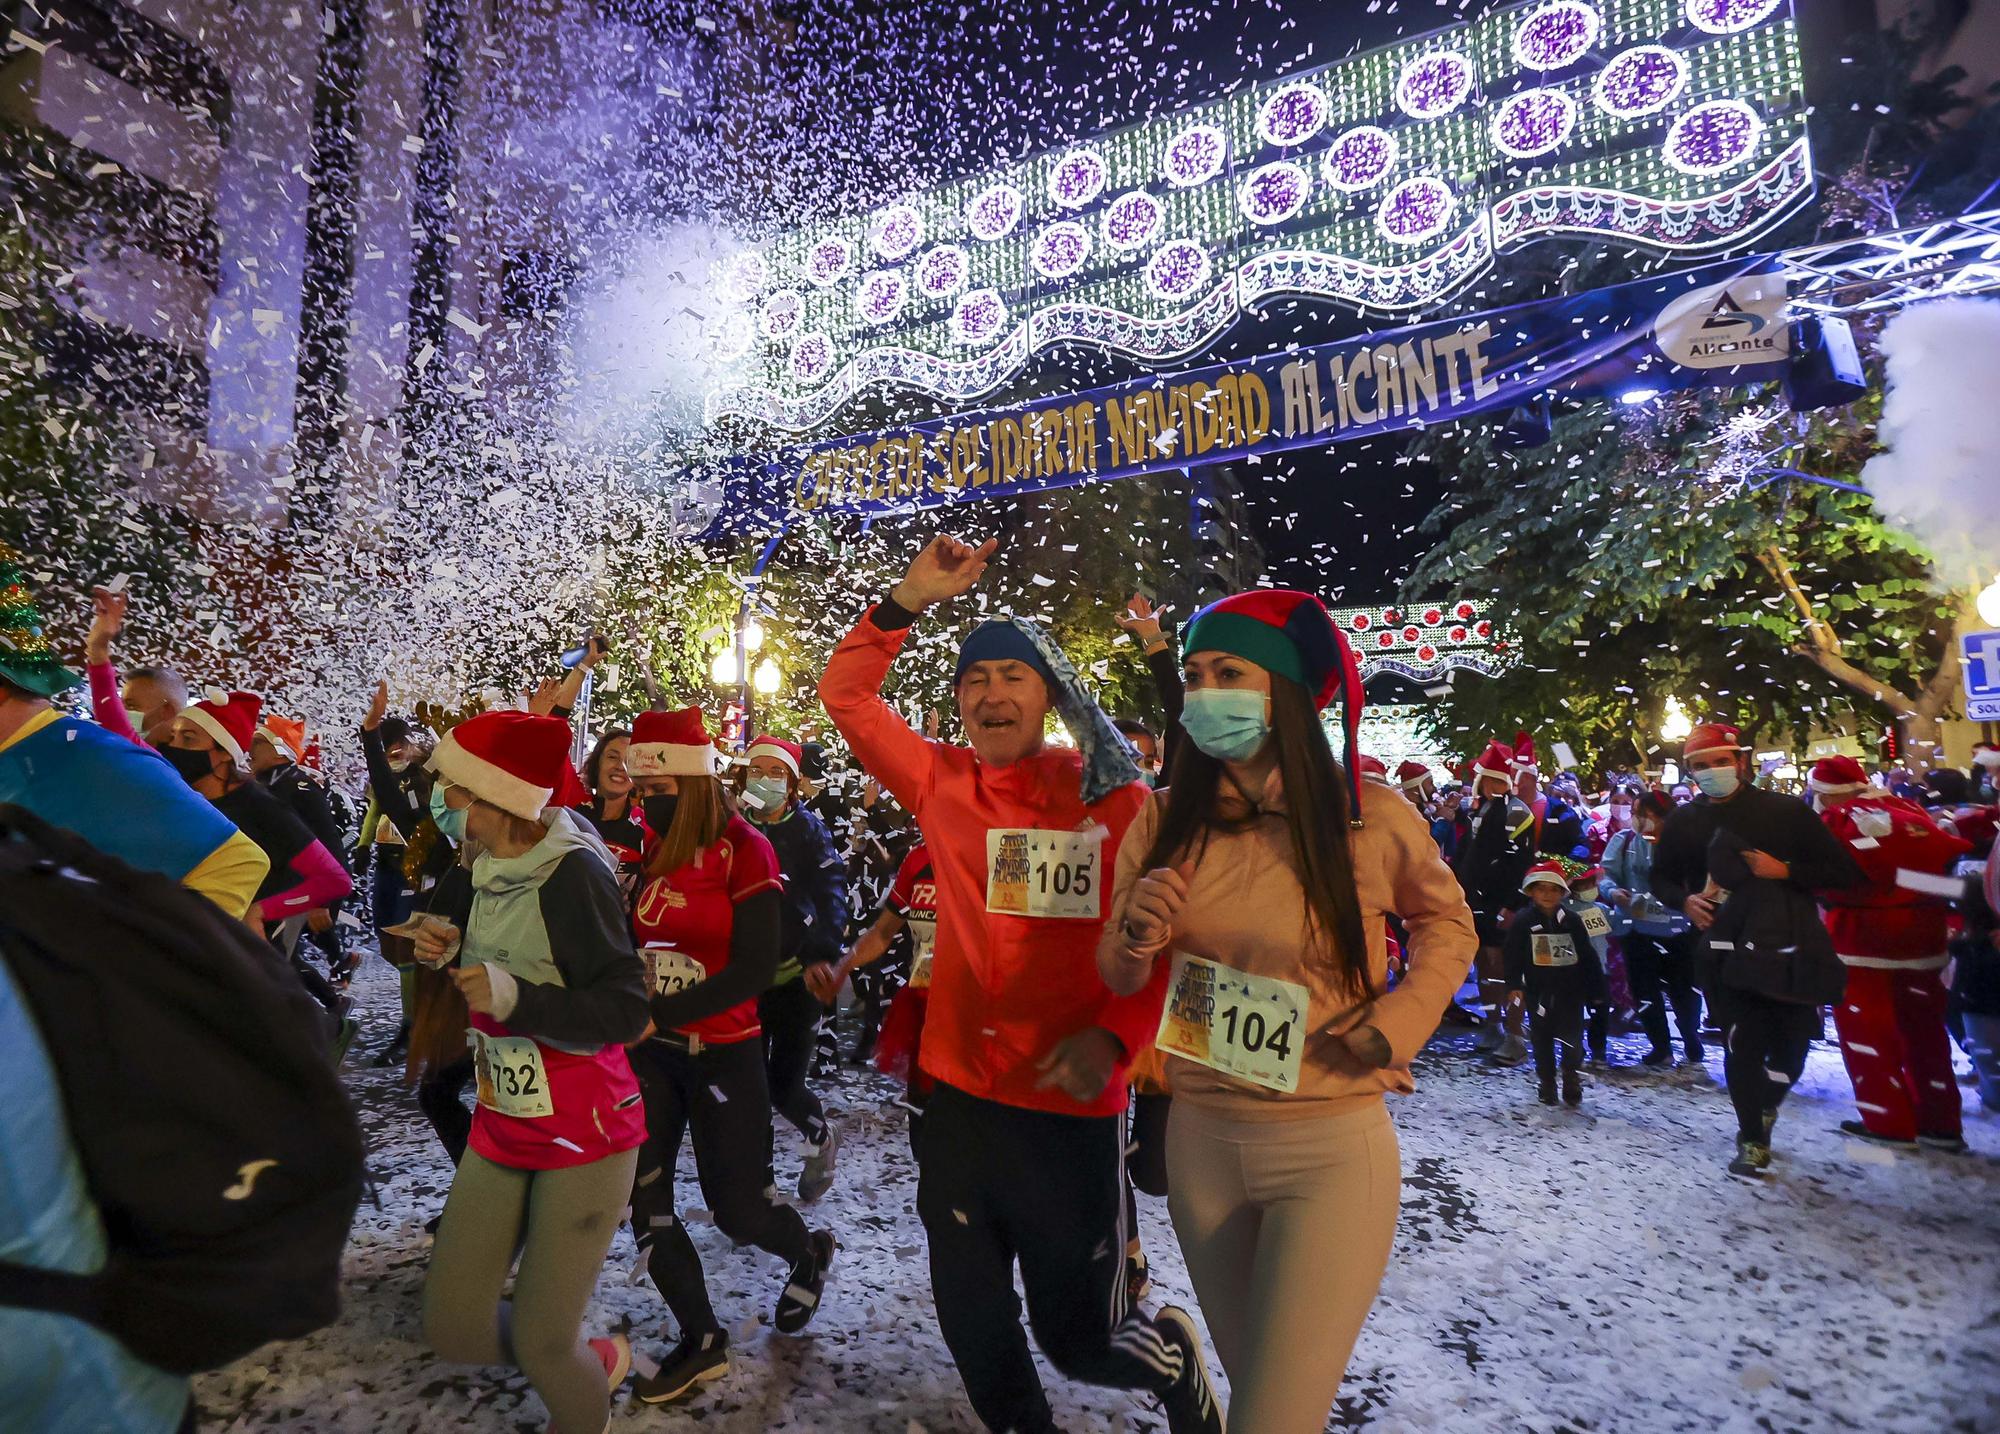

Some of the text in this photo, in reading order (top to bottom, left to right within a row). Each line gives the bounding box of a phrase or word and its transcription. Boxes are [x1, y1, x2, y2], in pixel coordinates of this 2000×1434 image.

[1689, 338, 1774, 357] Alicante
[796, 325, 1499, 511] CARRERA SOLIDARIA NAVIDAD ALICANTE
[1978, 704, 2000, 713] SOL
[1036, 861, 1091, 896] 105
[1585, 917, 1605, 929] 858
[1222, 1005, 1291, 1061] 104
[493, 1064, 539, 1096] 732
